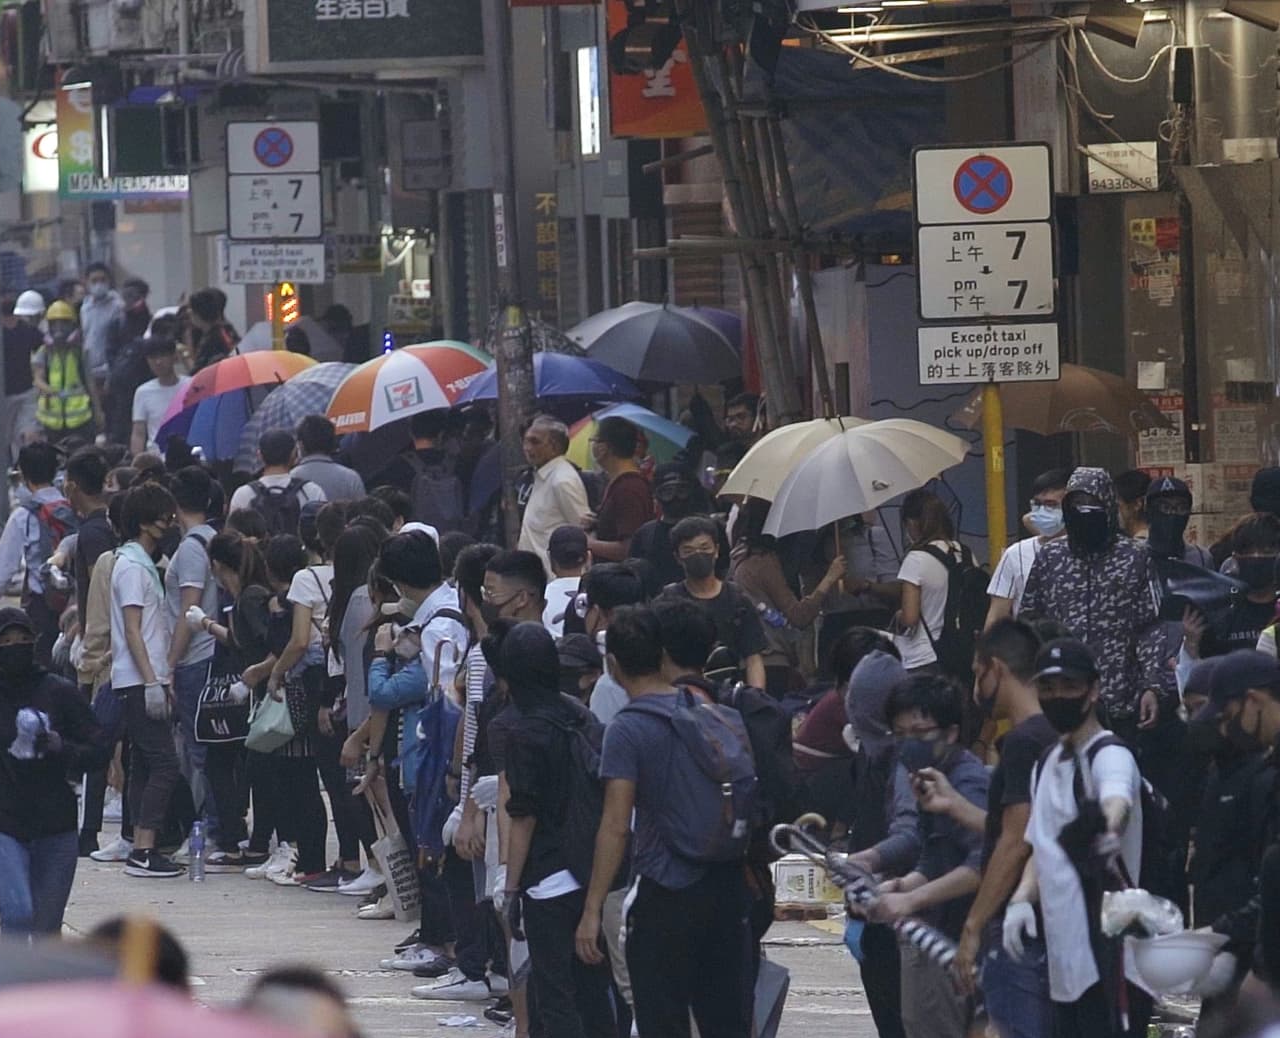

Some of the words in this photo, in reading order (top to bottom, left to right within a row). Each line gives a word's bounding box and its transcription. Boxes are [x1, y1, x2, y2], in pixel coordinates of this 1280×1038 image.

[315, 0, 410, 20] 生活百貨
[288, 179, 303, 201] 7
[289, 212, 304, 234] 7
[952, 230, 975, 242] am
[946, 246, 984, 263] 上午
[1006, 231, 1027, 261] 7
[954, 279, 977, 292] pm
[947, 296, 985, 312] 下午
[1007, 280, 1028, 310] 7
[951, 331, 998, 346] Except
[1002, 329, 1026, 342] taxi
[934, 346, 962, 360] pick
[966, 345, 1020, 359] up/drop
[1023, 344, 1043, 355] off
[927, 360, 1051, 379] 的士上落客除外
